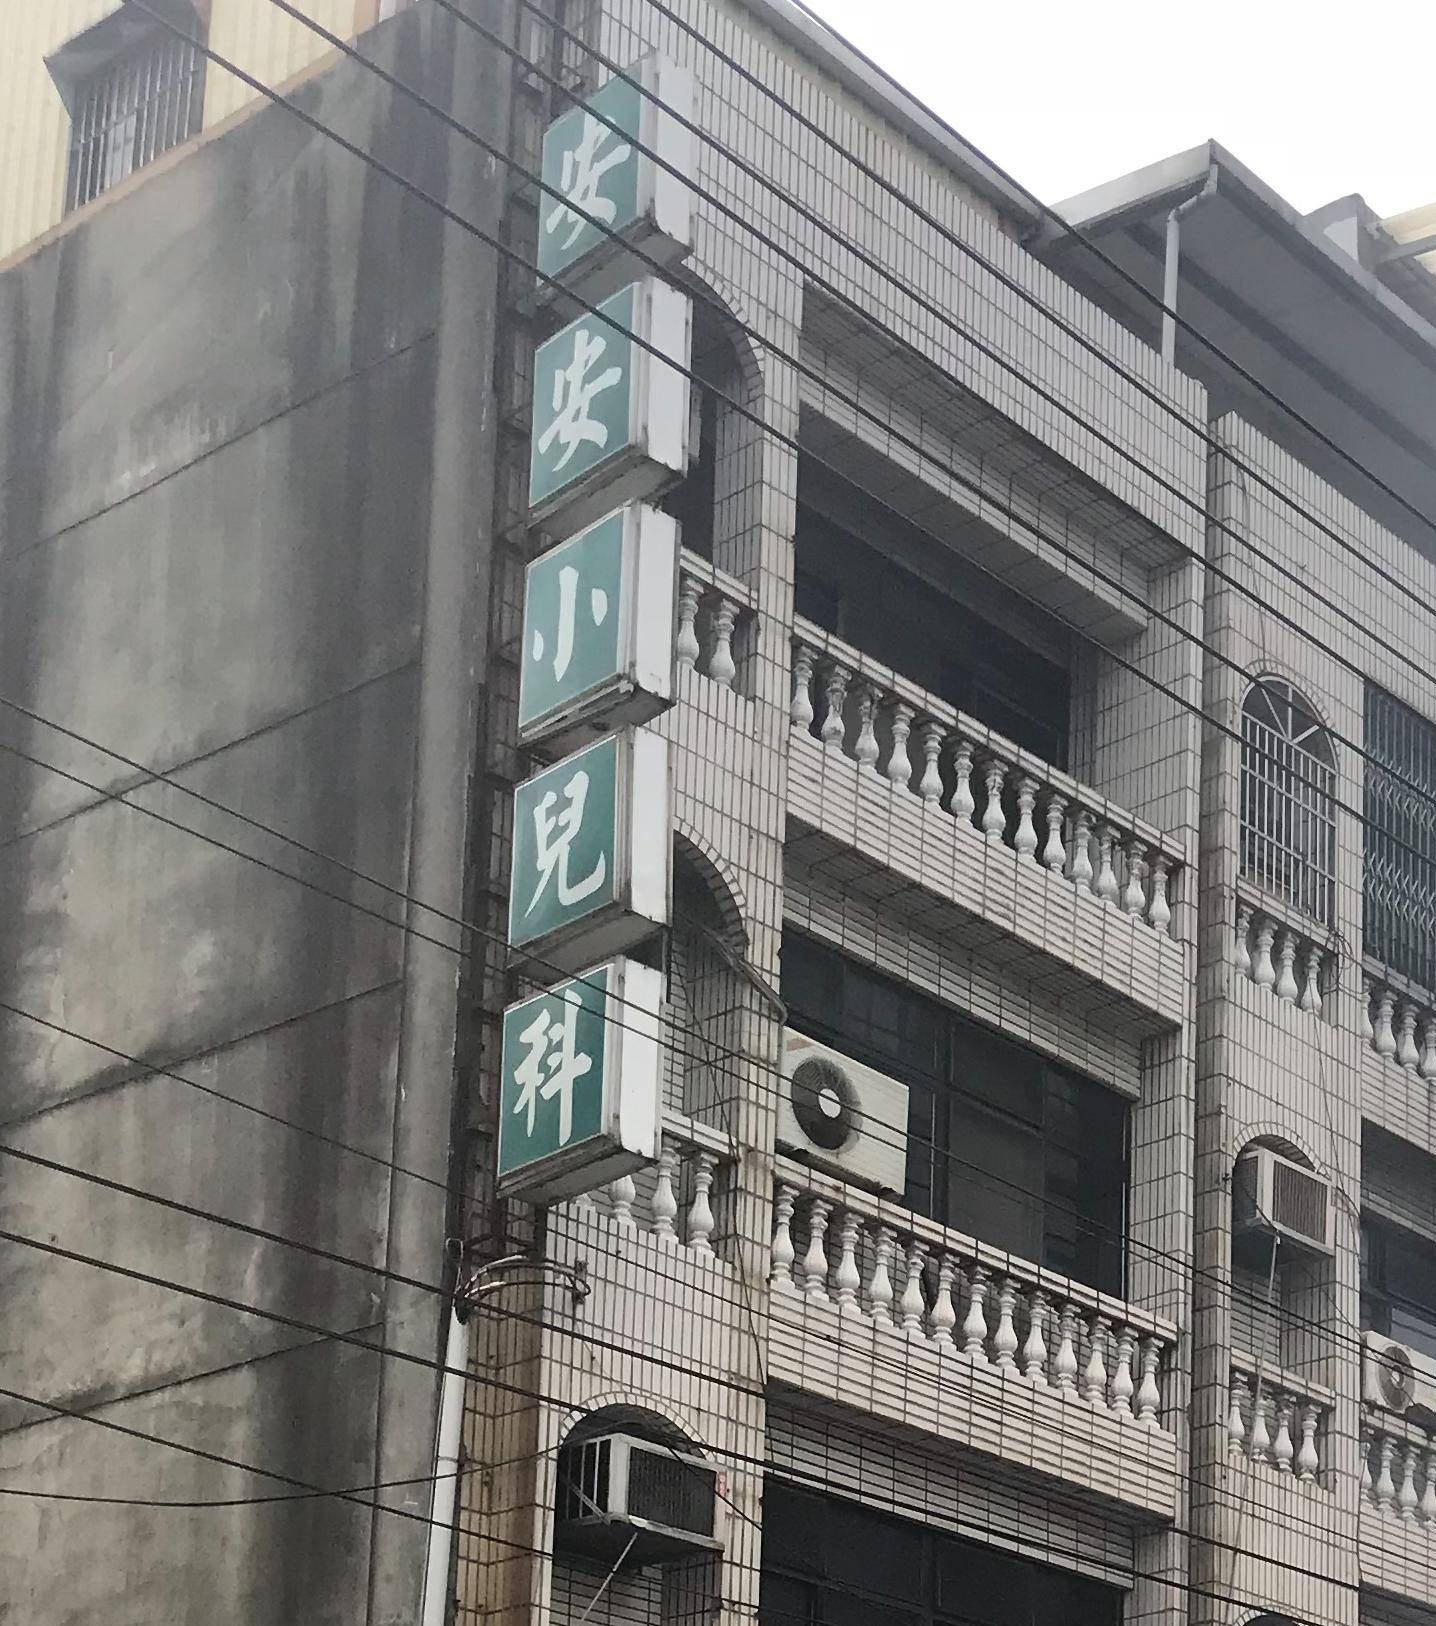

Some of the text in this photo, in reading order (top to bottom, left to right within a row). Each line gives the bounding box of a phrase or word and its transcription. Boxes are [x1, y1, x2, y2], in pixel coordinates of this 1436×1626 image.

[513, 114, 632, 1148] 安安小兒科
